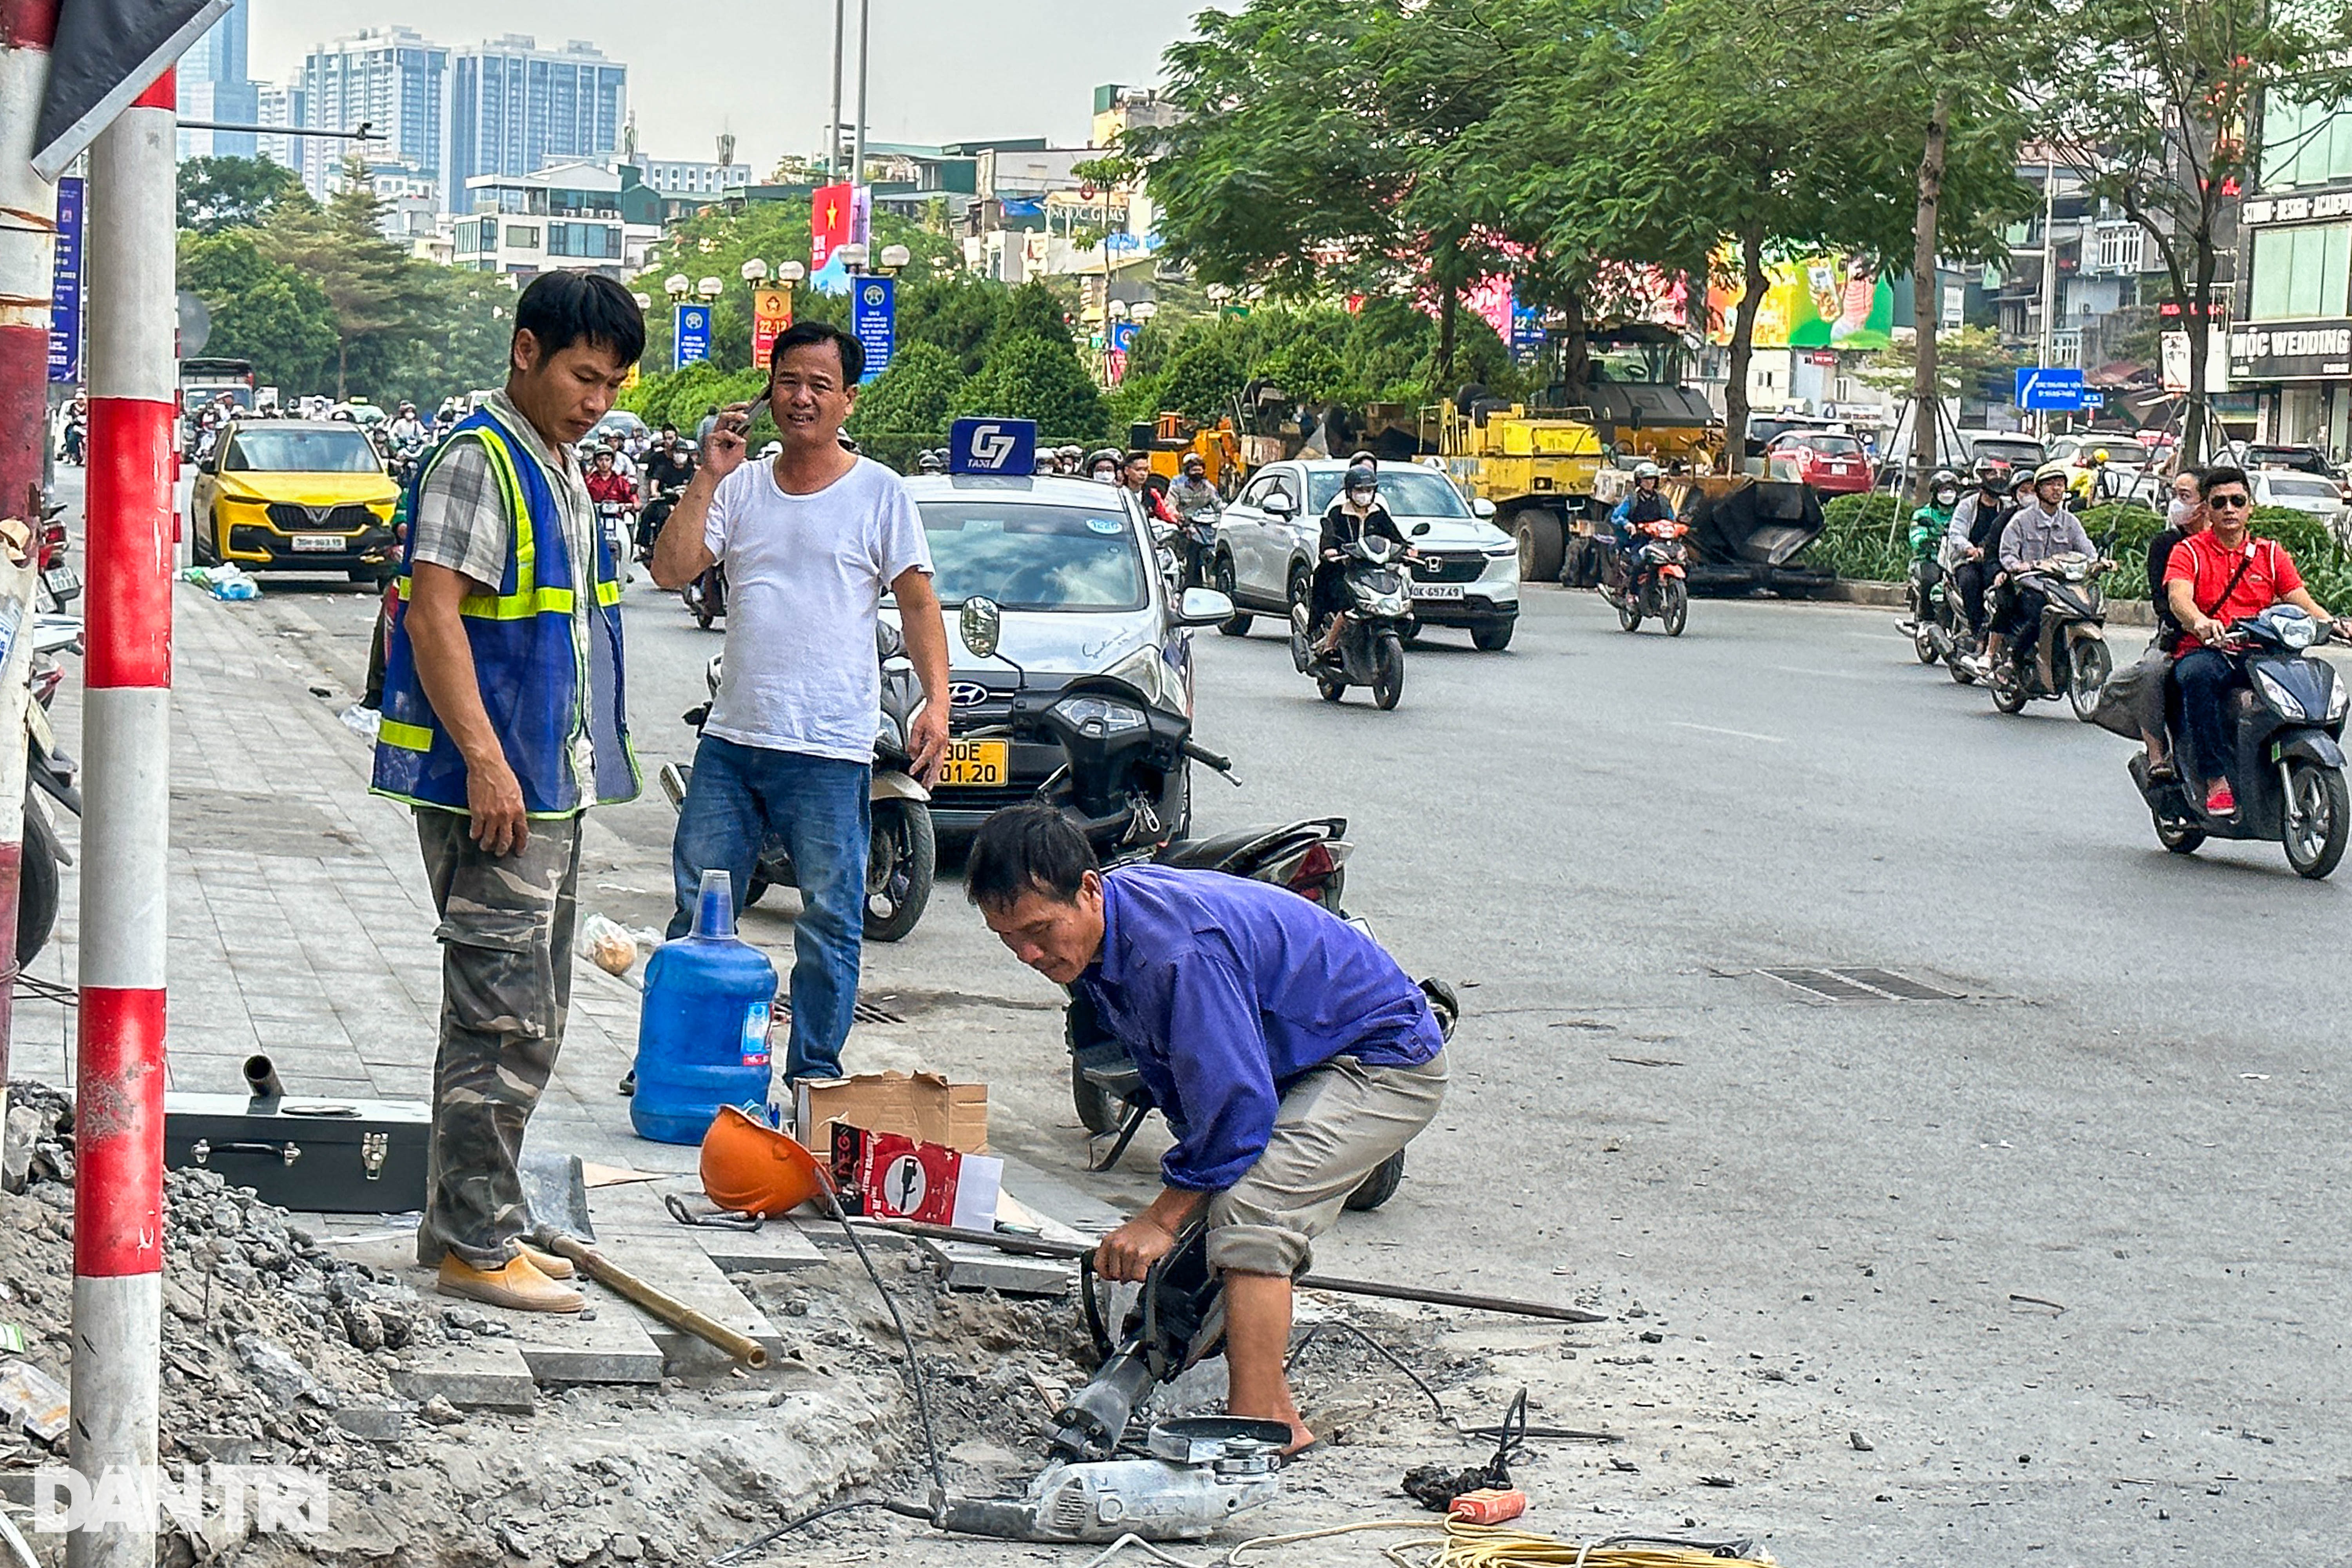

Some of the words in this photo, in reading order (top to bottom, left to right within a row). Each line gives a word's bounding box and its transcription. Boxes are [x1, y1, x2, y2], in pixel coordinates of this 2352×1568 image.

[2231, 326, 2270, 363] MỘC
[2271, 328, 2351, 356] WEDDING
[971, 425, 1016, 469] G7
[967, 458, 991, 468] TAXI
[940, 764, 996, 782] 01.20
